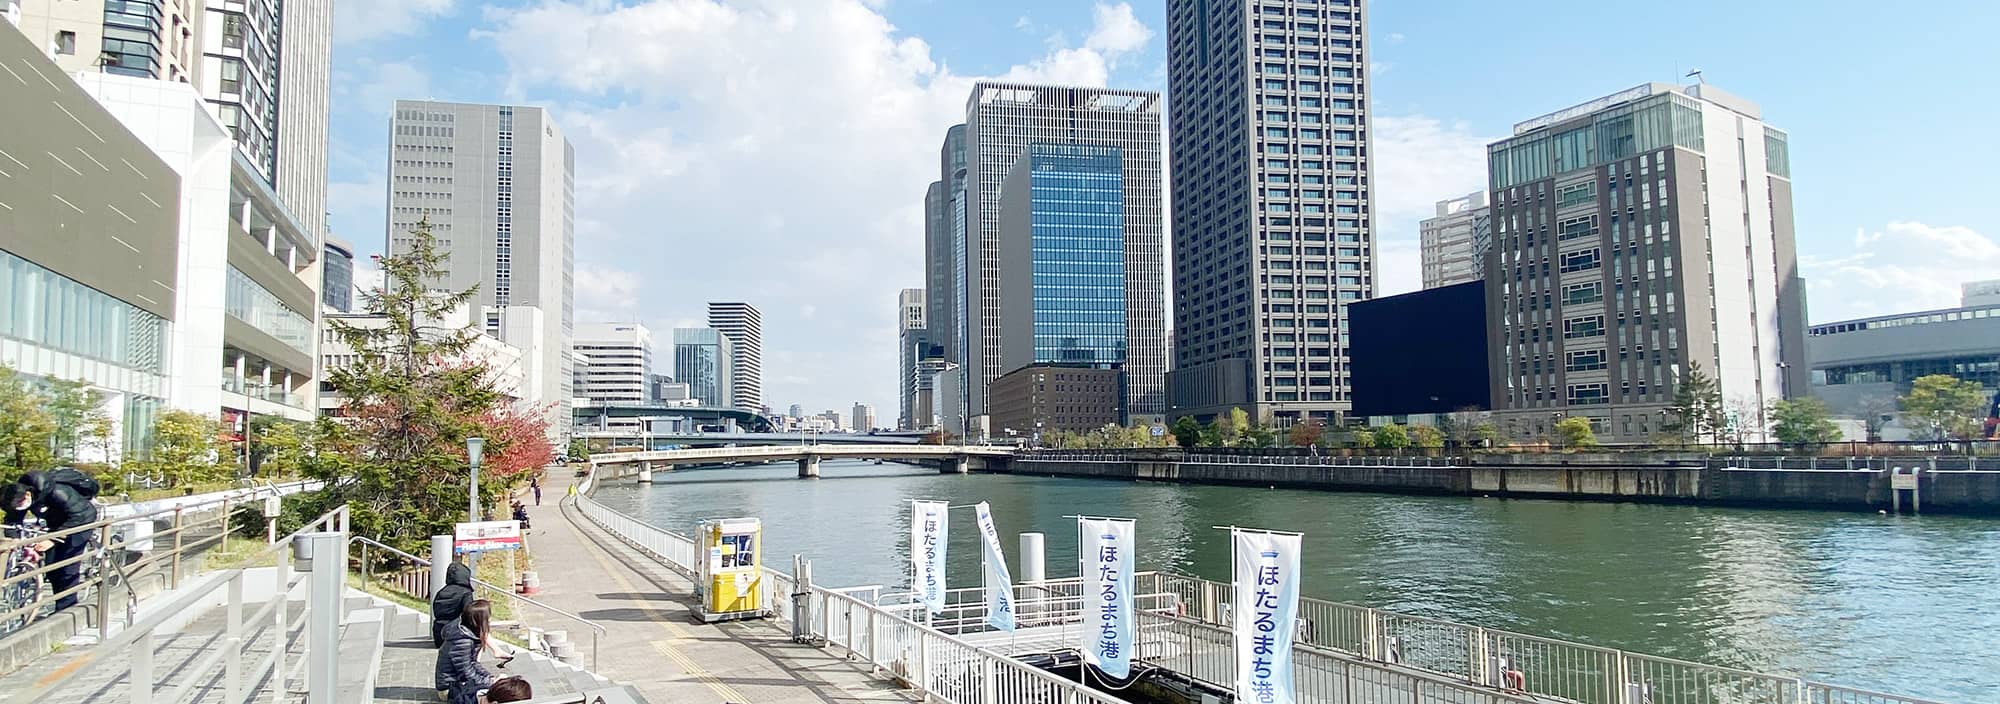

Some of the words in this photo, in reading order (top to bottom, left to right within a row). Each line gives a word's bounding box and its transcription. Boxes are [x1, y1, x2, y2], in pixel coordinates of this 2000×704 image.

[1100, 546, 1119, 659] ほたるまち港
[1252, 566, 1279, 704] ほたるまち港
